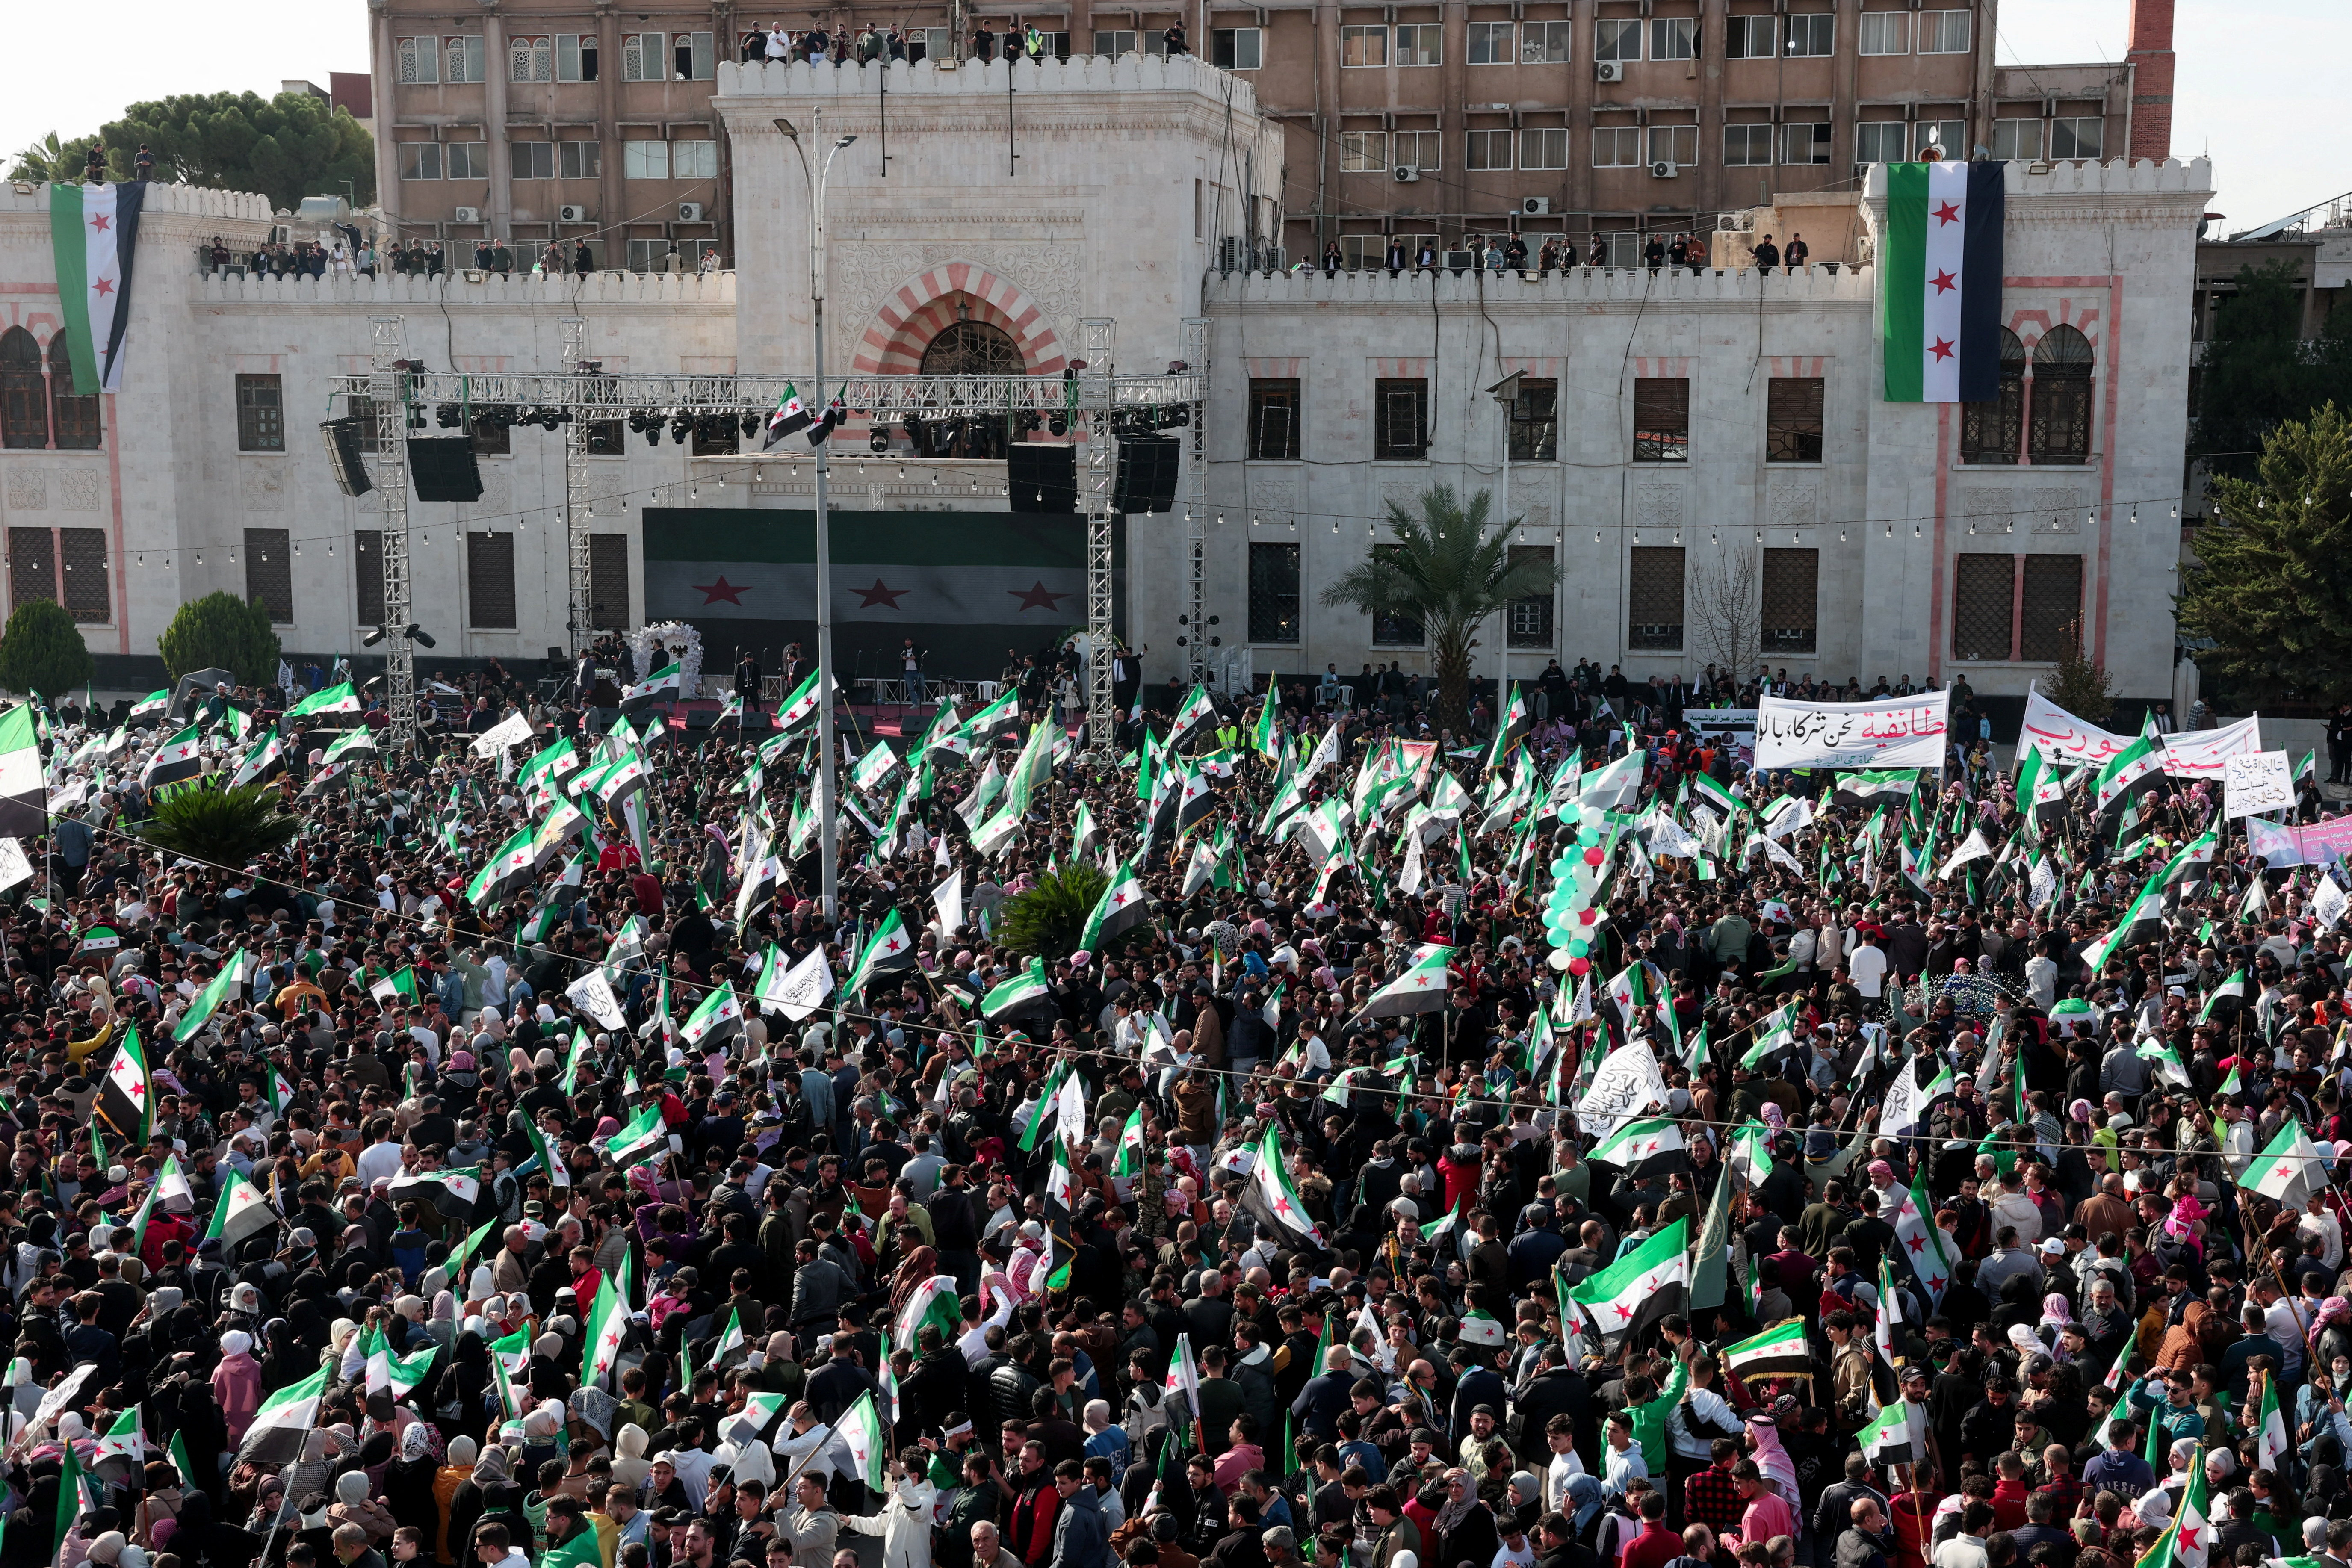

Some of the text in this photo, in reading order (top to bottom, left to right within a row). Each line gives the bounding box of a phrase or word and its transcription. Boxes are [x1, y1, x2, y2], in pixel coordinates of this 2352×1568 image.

[1690, 714, 1718, 722] الهاشمية
[1732, 715, 1744, 723] بني
[1787, 711, 1826, 745] شركاء
[1823, 712, 1855, 747] نحن
[1814, 754, 1875, 766] حماة حي الحميدية
[1797, 1456, 1822, 1481] EASY
[2099, 1482, 2141, 1497] DIESEL
